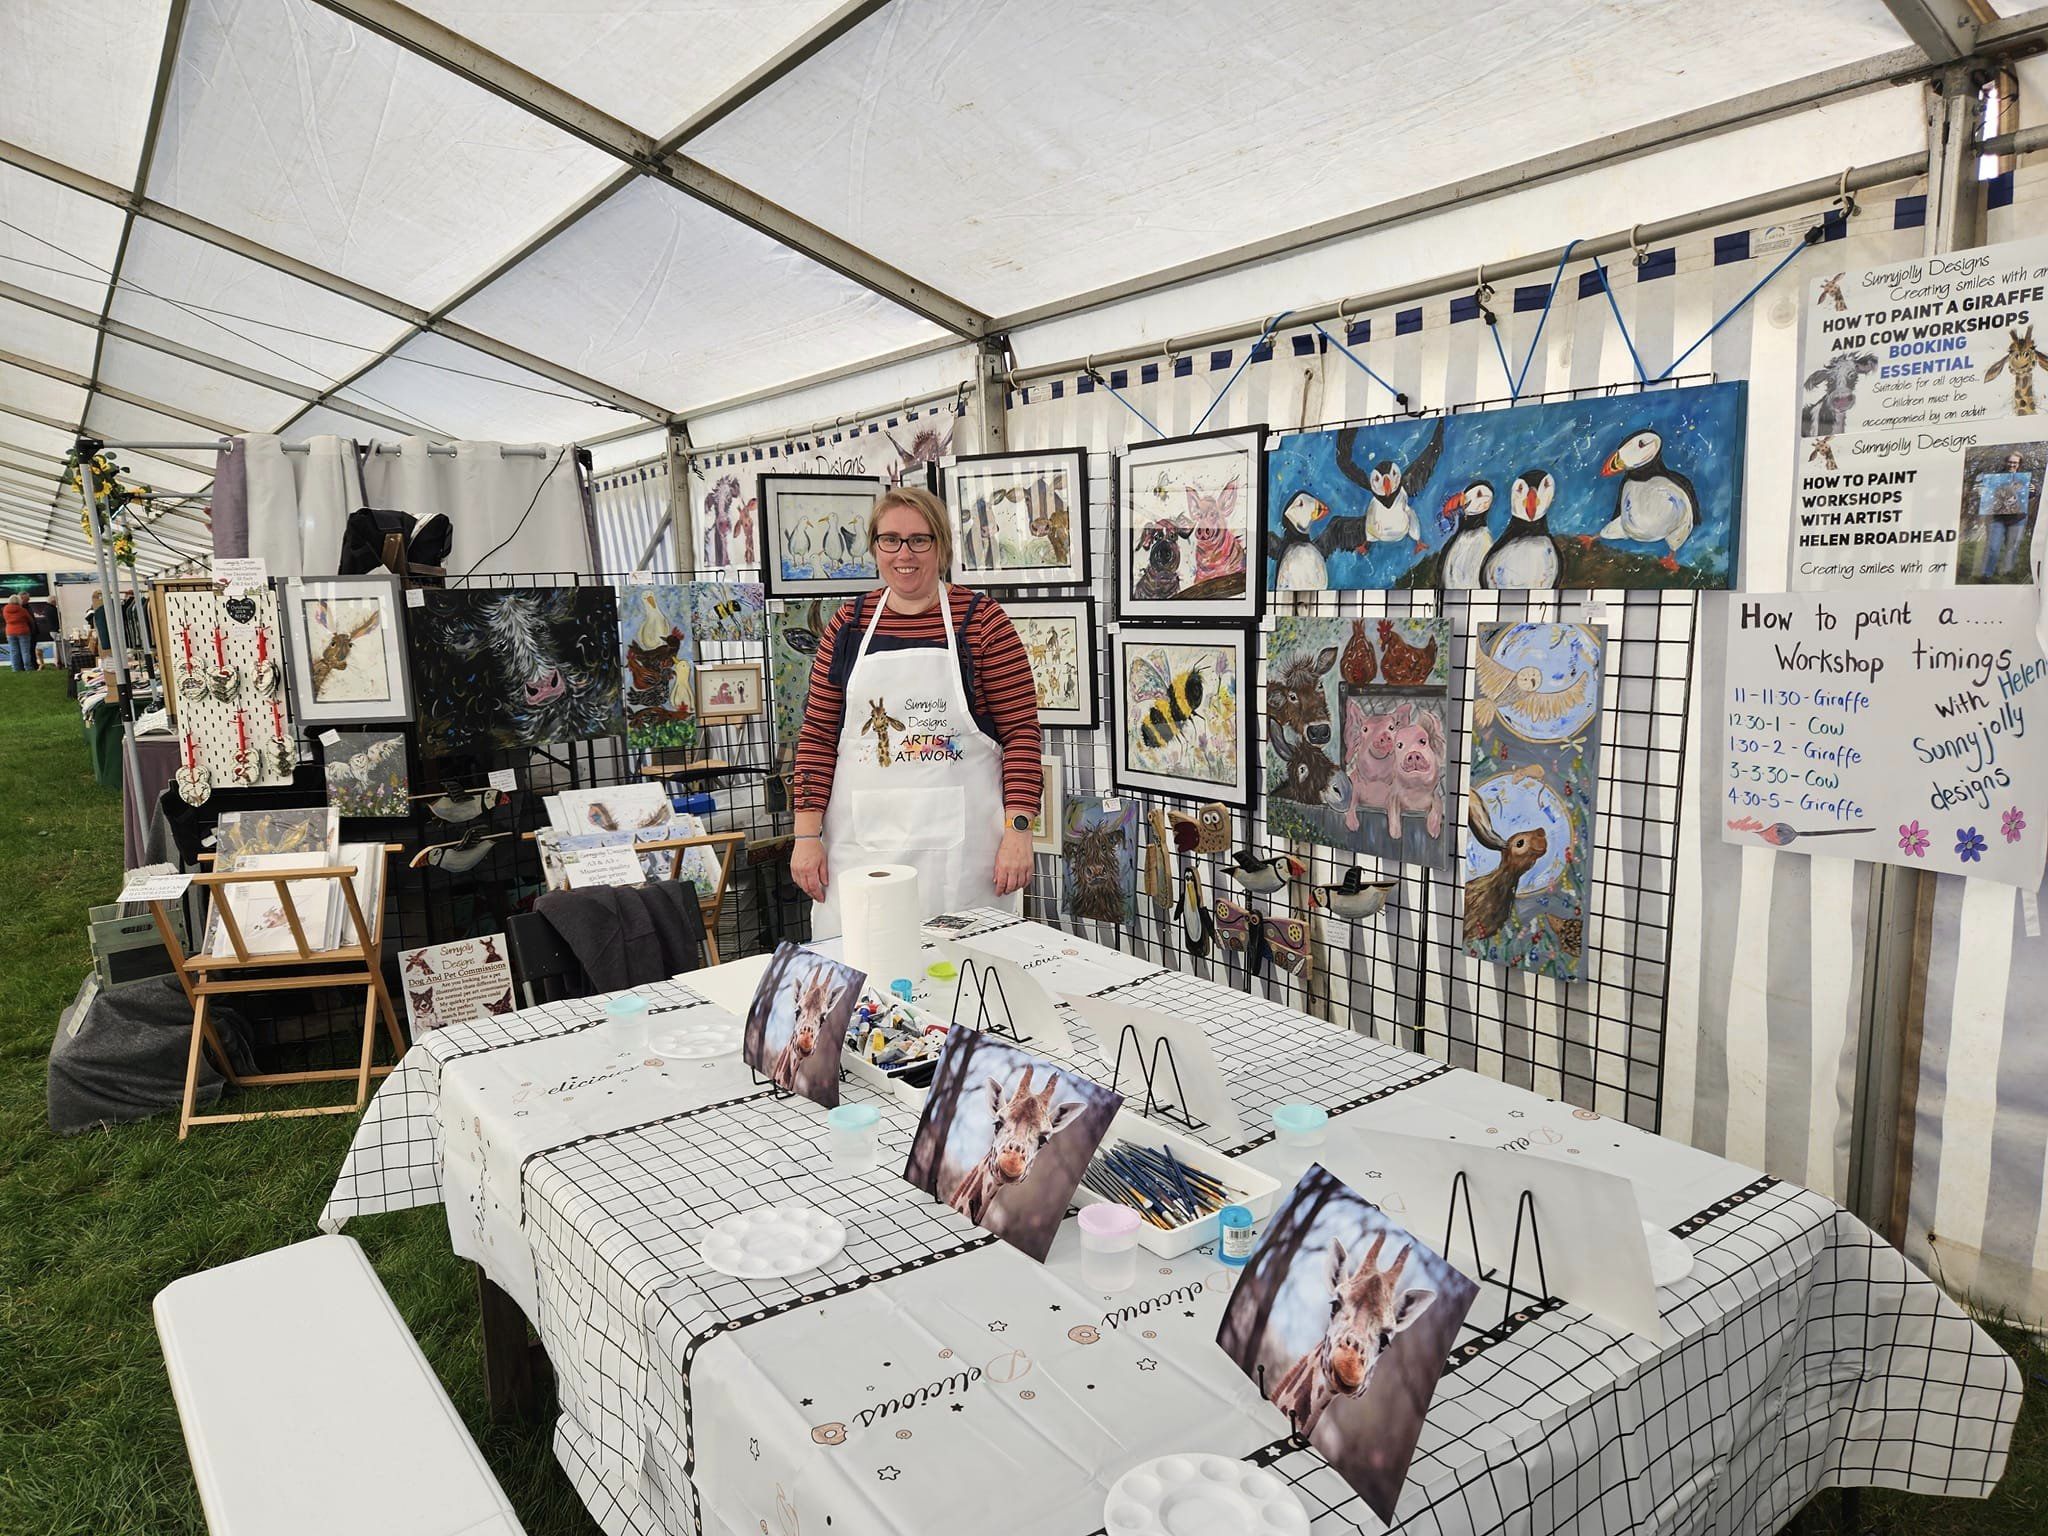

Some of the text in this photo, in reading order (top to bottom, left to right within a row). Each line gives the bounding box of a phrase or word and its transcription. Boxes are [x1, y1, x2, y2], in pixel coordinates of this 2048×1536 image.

[1861, 255, 1990, 288] Sunnyjolly Designs
[1890, 282, 1951, 301] Creating
[1955, 275, 1996, 292] smiles
[2001, 266, 2028, 284] with
[1822, 286, 2044, 333] HOW TO PAINT A GIRAFFE
[1831, 310, 2030, 352] AND COW WORKSHOPS
[1889, 335, 1968, 359] BOOKING
[1880, 356, 1974, 379] ESSENTIAL
[1872, 380, 1913, 394] Suitable
[1914, 377, 1930, 391] for
[1932, 375, 1946, 386] all
[1881, 390, 1968, 409] Children must be
[1861, 404, 1988, 430] accompanied by an adult
[1851, 433, 1978, 458] Sunnyjolly Designs
[1803, 470, 1918, 490] HOW TO PAINT
[1802, 490, 1903, 508] WORKSHOPS
[1800, 509, 1904, 527] WITH ARTIST
[1799, 529, 1958, 547] HELEN BROADHEAD
[1800, 559, 1949, 580] Creating smiles with art
[1740, 602, 1794, 631] How
[1815, 603, 1837, 631] to
[1855, 601, 1913, 640] paint
[1774, 638, 2012, 687] Workshop timings
[904, 697, 948, 713] Sunnyjolly
[1813, 688, 1870, 714] Giraffe
[1934, 690, 1990, 719] with
[908, 716, 948, 731] Designs
[1807, 716, 1845, 736] Cow
[900, 734, 956, 746] ARTIST
[895, 750, 964, 762] AT WORK
[1803, 741, 1862, 769] Giraffe
[1804, 769, 1840, 789] Cow
[1930, 767, 2011, 812] designs
[1799, 793, 1864, 821] Giraffe
[408, 963, 507, 988] Dog And Pet Commissions
